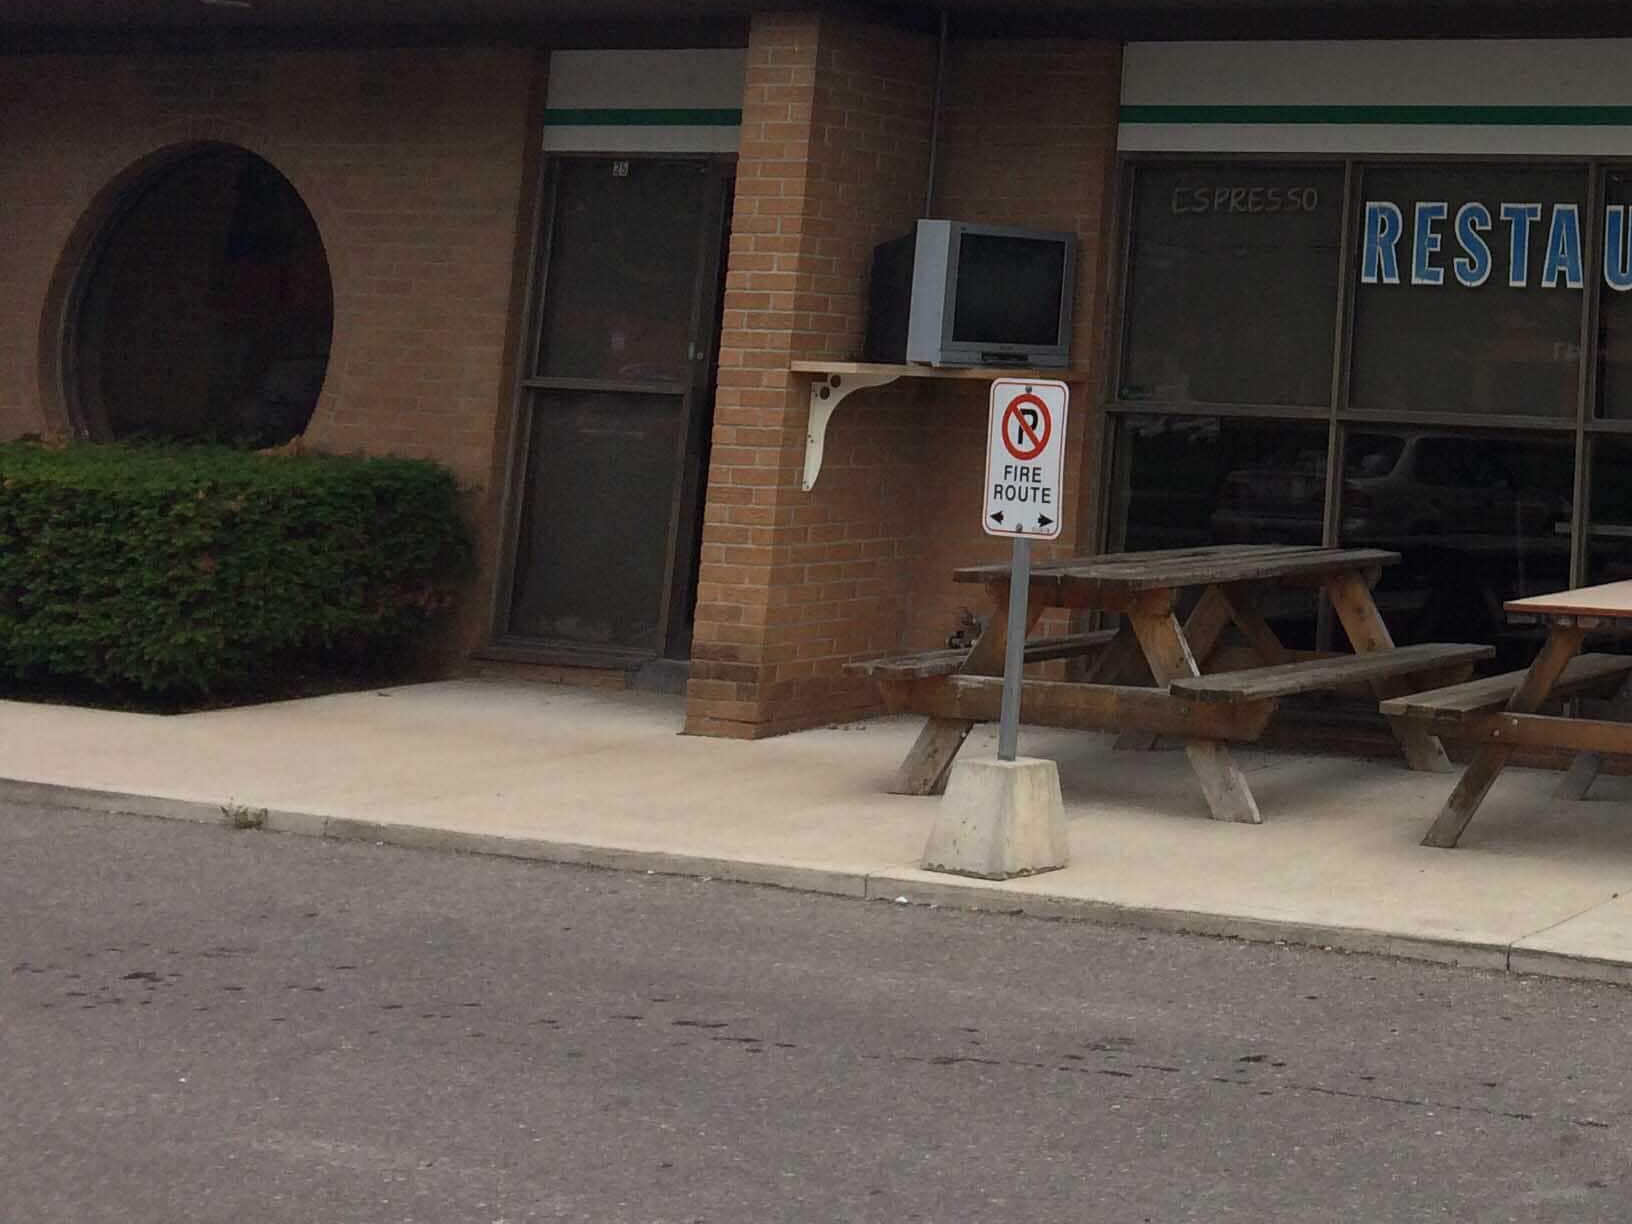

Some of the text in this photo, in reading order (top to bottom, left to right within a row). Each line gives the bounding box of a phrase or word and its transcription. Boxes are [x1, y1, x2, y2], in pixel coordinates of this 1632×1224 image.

[1171, 185, 1319, 215] ESPRESSO
[1003, 464, 1042, 484] FIRE
[992, 484, 1052, 504] ROUTE
